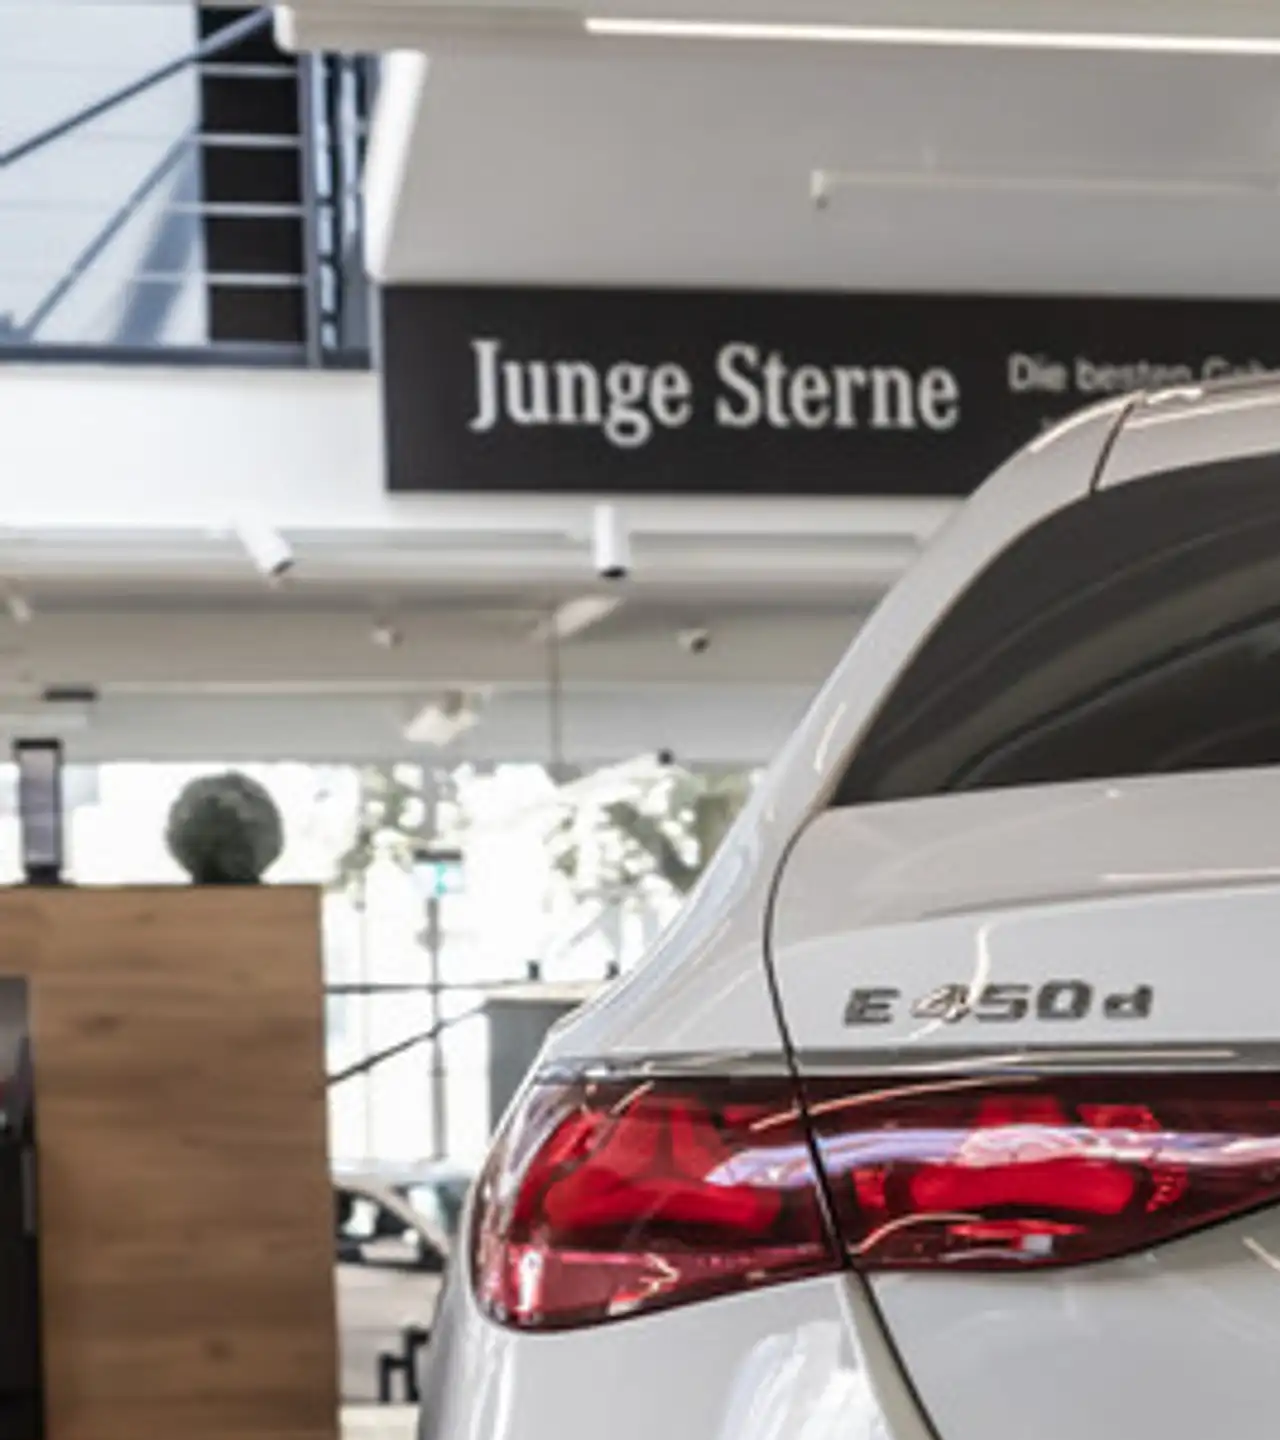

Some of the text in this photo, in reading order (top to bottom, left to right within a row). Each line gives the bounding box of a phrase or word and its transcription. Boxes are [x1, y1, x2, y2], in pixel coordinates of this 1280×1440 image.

[470, 339, 959, 446] Junge Sterne
[1008, 353, 1067, 392] Die
[1075, 356, 1192, 391] besten
[844, 980, 1154, 1026] E 450 d
